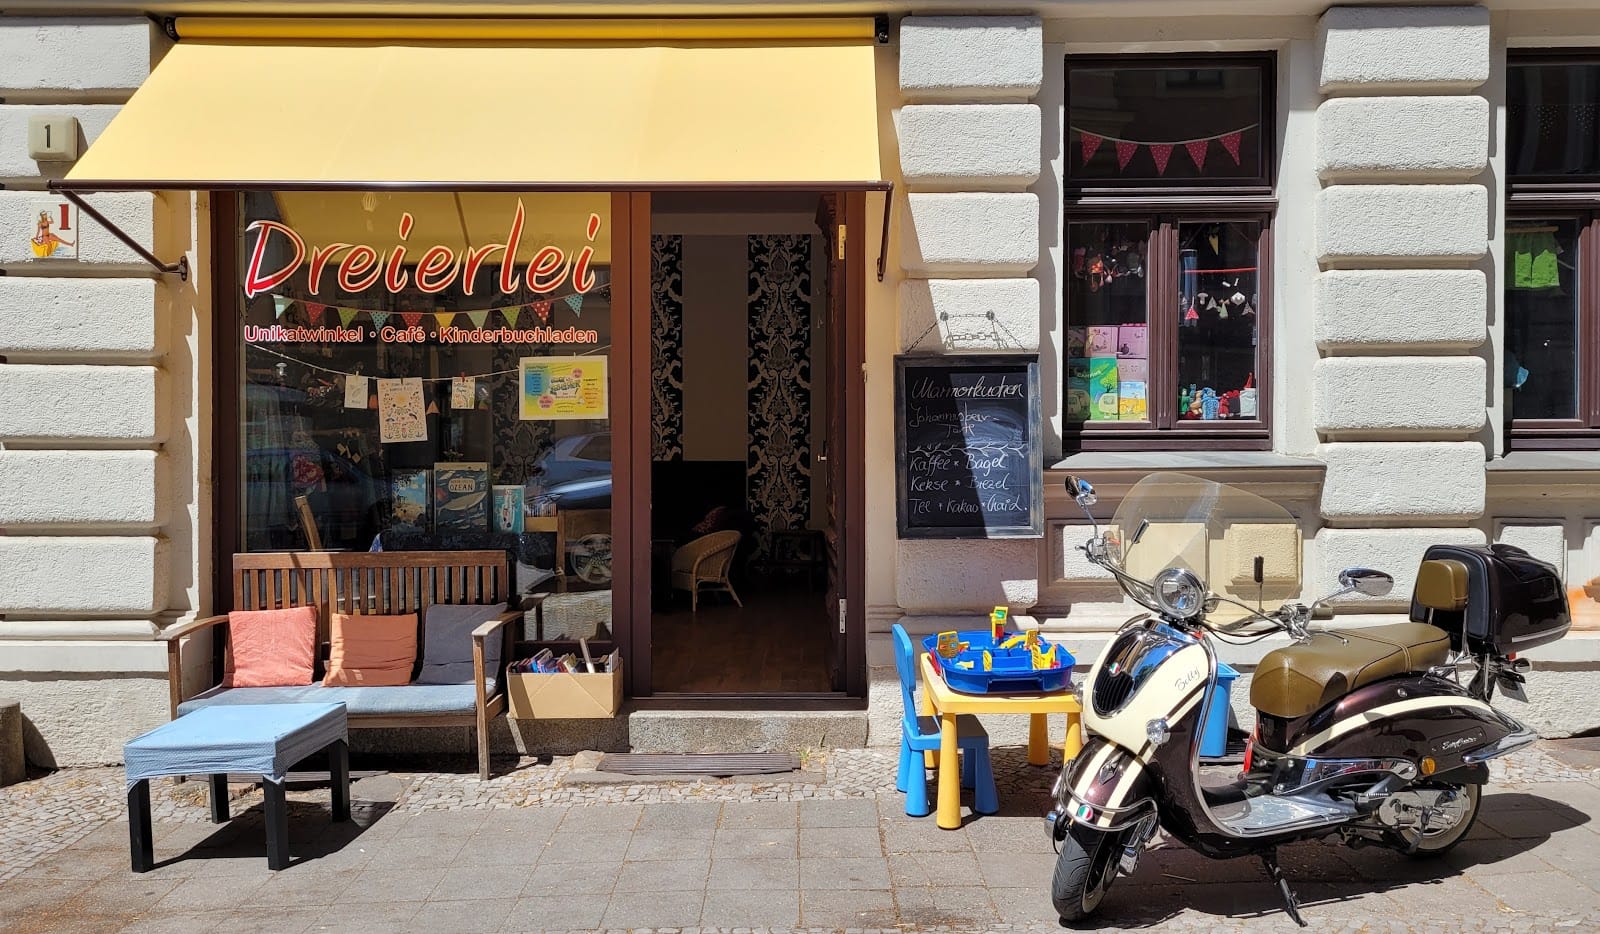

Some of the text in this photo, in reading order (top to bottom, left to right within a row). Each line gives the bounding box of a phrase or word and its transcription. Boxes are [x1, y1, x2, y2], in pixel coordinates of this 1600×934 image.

[44, 124, 51, 149] 1
[59, 204, 71, 230] 1
[244, 197, 602, 299] Dreierlei
[244, 325, 598, 344] Unikatwinkel Café Kinderbuchladen
[911, 375, 1024, 399] Marmorkuchen
[909, 452, 1008, 477] Kaffee Bagel
[910, 472, 1010, 492] Kekse Brezel
[908, 498, 932, 514] Tee
[946, 497, 979, 514] Kakao
